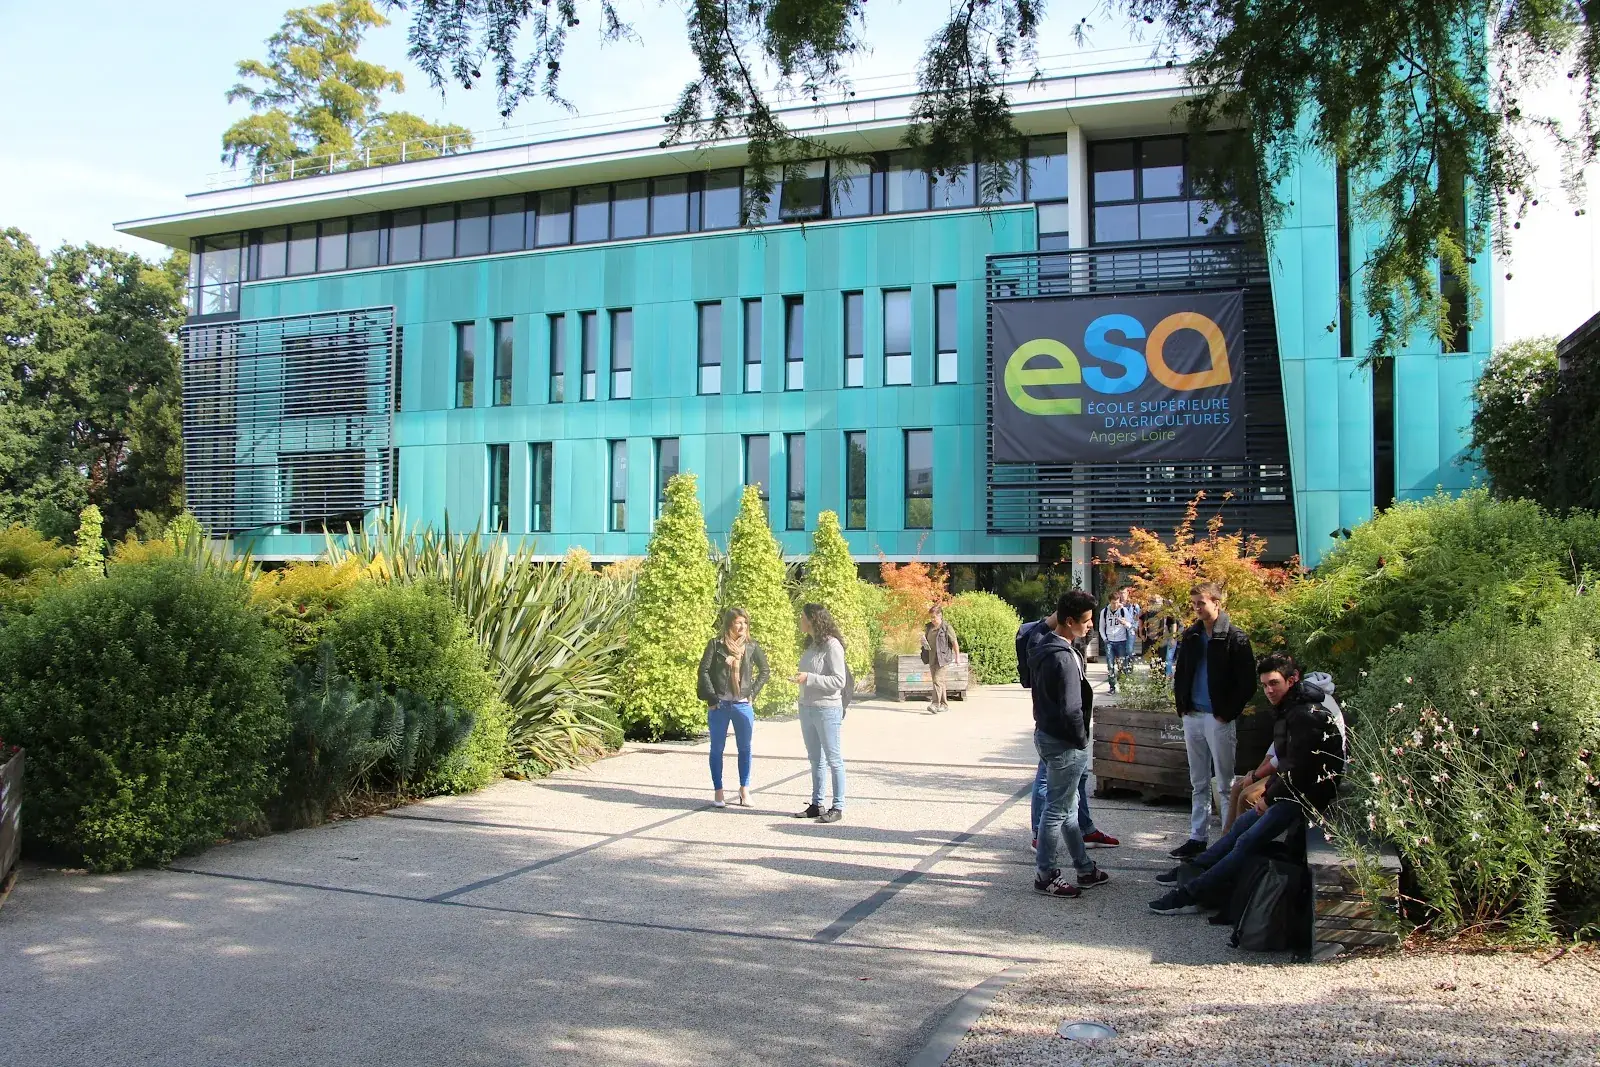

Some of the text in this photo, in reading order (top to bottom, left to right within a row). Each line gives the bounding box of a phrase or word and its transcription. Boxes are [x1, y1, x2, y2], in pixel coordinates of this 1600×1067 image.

[1004, 311, 1232, 416] esa
[1087, 398, 1230, 415] ÉCOLE SUPÉRIEURE
[1105, 412, 1230, 429] D'AGRICULTURES
[1089, 429, 1176, 446] Angers Loire
